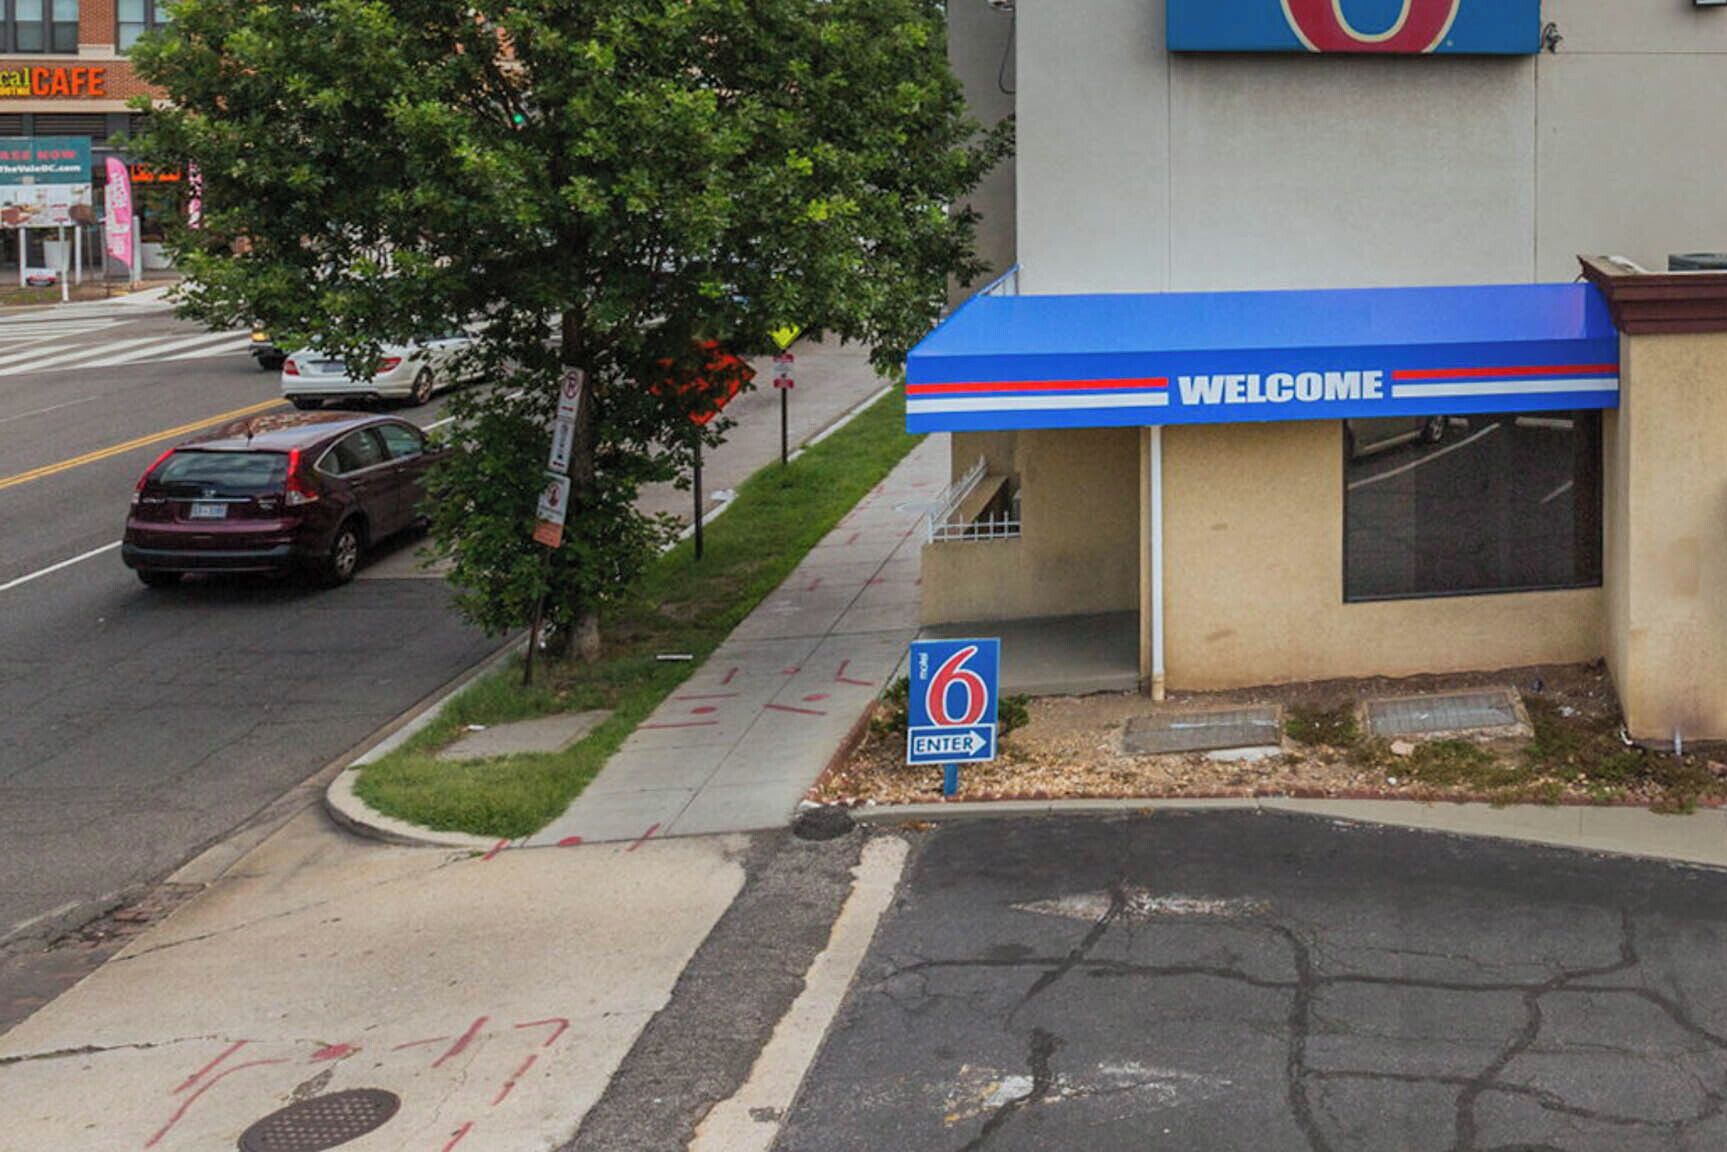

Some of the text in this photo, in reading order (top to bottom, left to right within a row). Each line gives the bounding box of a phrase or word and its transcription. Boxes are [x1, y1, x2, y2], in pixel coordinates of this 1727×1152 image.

[31, 66, 106, 96] CAFE
[1177, 369, 1384, 406] WELCOME
[925, 645, 989, 727] 6
[915, 736, 974, 753] ENTER
